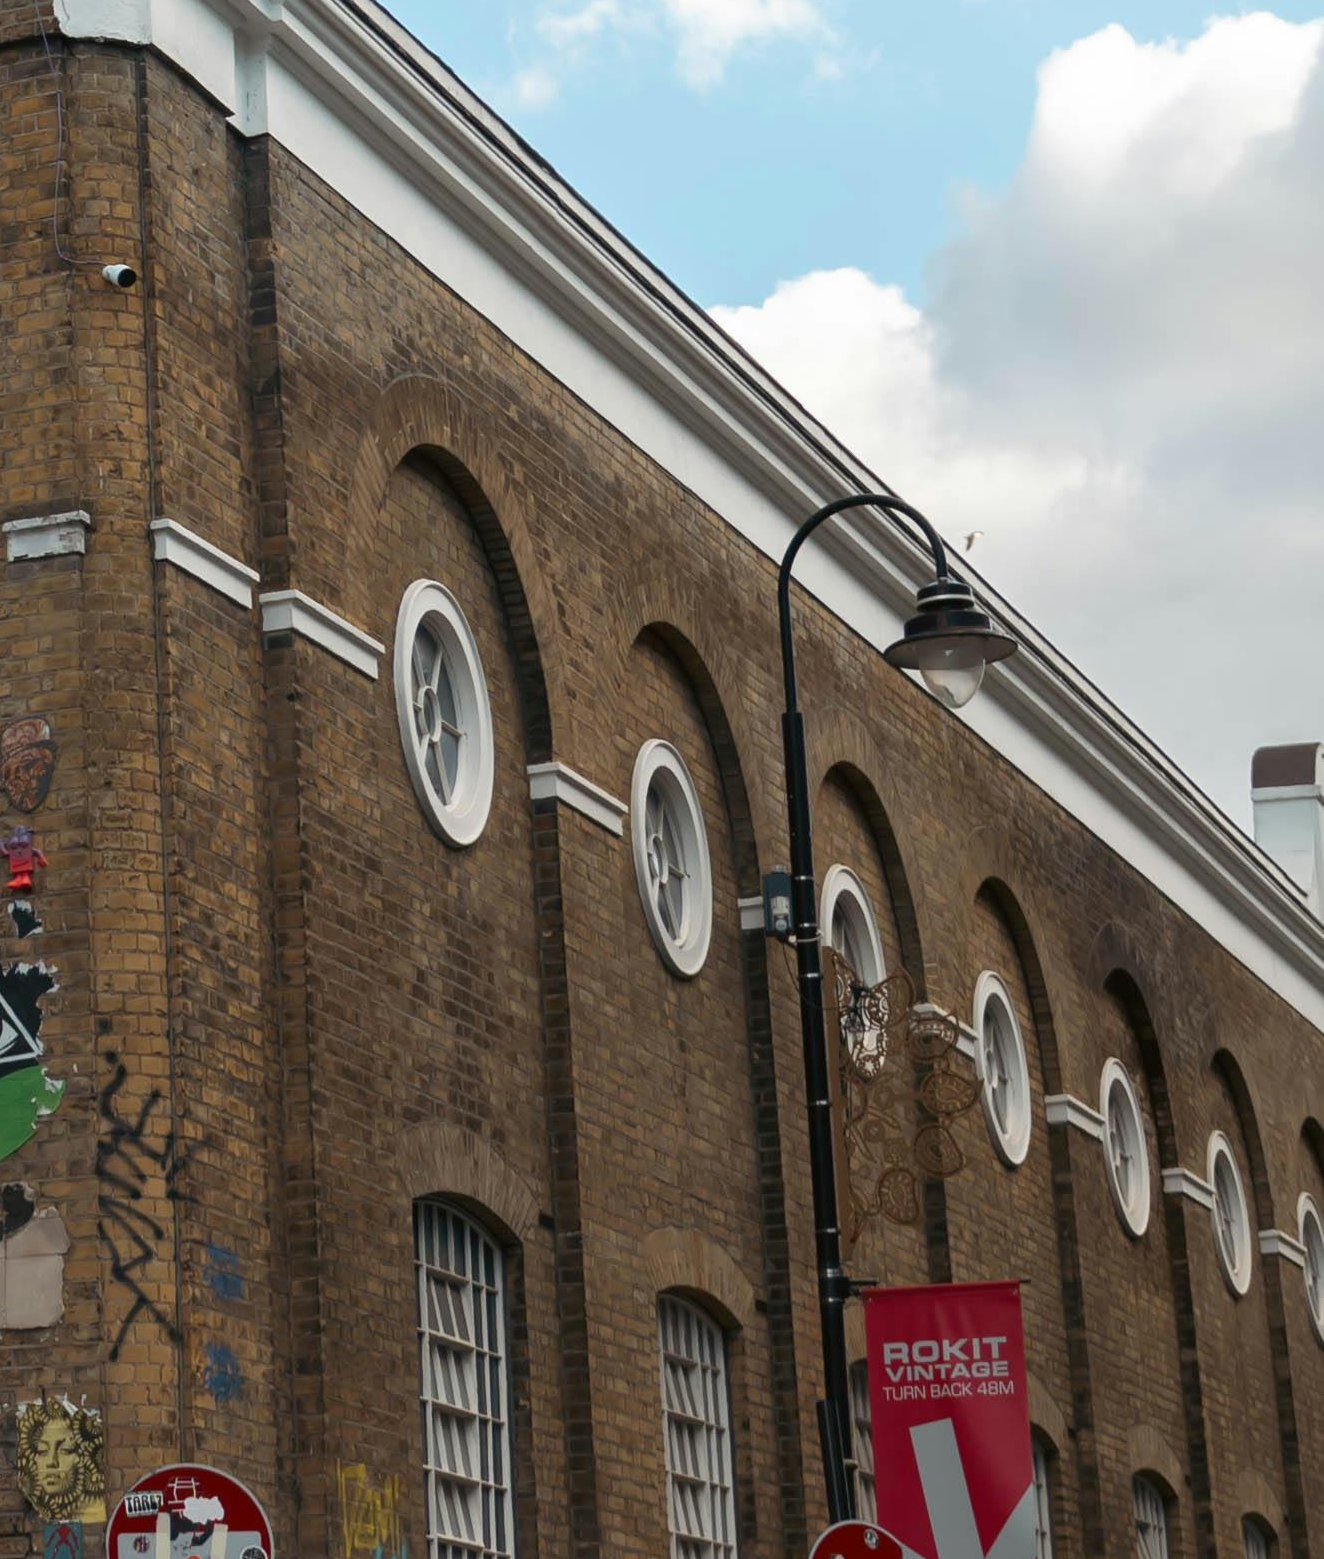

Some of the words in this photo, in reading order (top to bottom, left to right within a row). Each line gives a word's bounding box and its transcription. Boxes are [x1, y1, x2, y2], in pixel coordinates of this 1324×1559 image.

[883, 1336, 1007, 1365] ROKIT
[885, 1360, 1009, 1383] VINTAGE
[883, 1384, 927, 1402] TURN
[931, 1381, 972, 1399] BACK
[977, 1380, 1014, 1396] 48M
